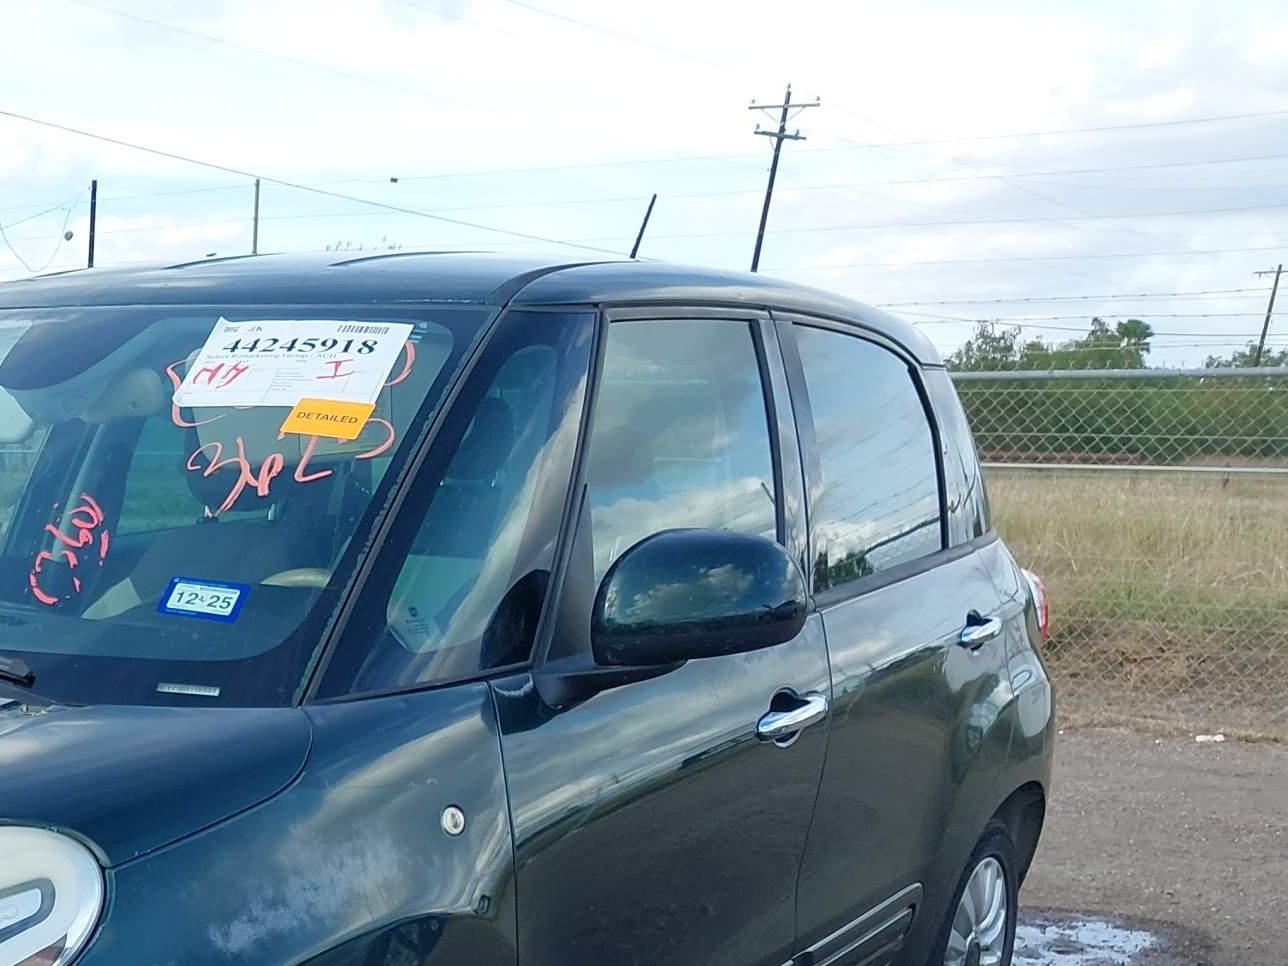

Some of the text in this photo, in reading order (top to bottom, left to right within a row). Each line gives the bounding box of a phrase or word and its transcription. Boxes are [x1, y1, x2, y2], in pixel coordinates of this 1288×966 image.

[222, 337, 379, 355] 44245918
[296, 411, 359, 424] DETAILED
[176, 591, 234, 610] 12 25
